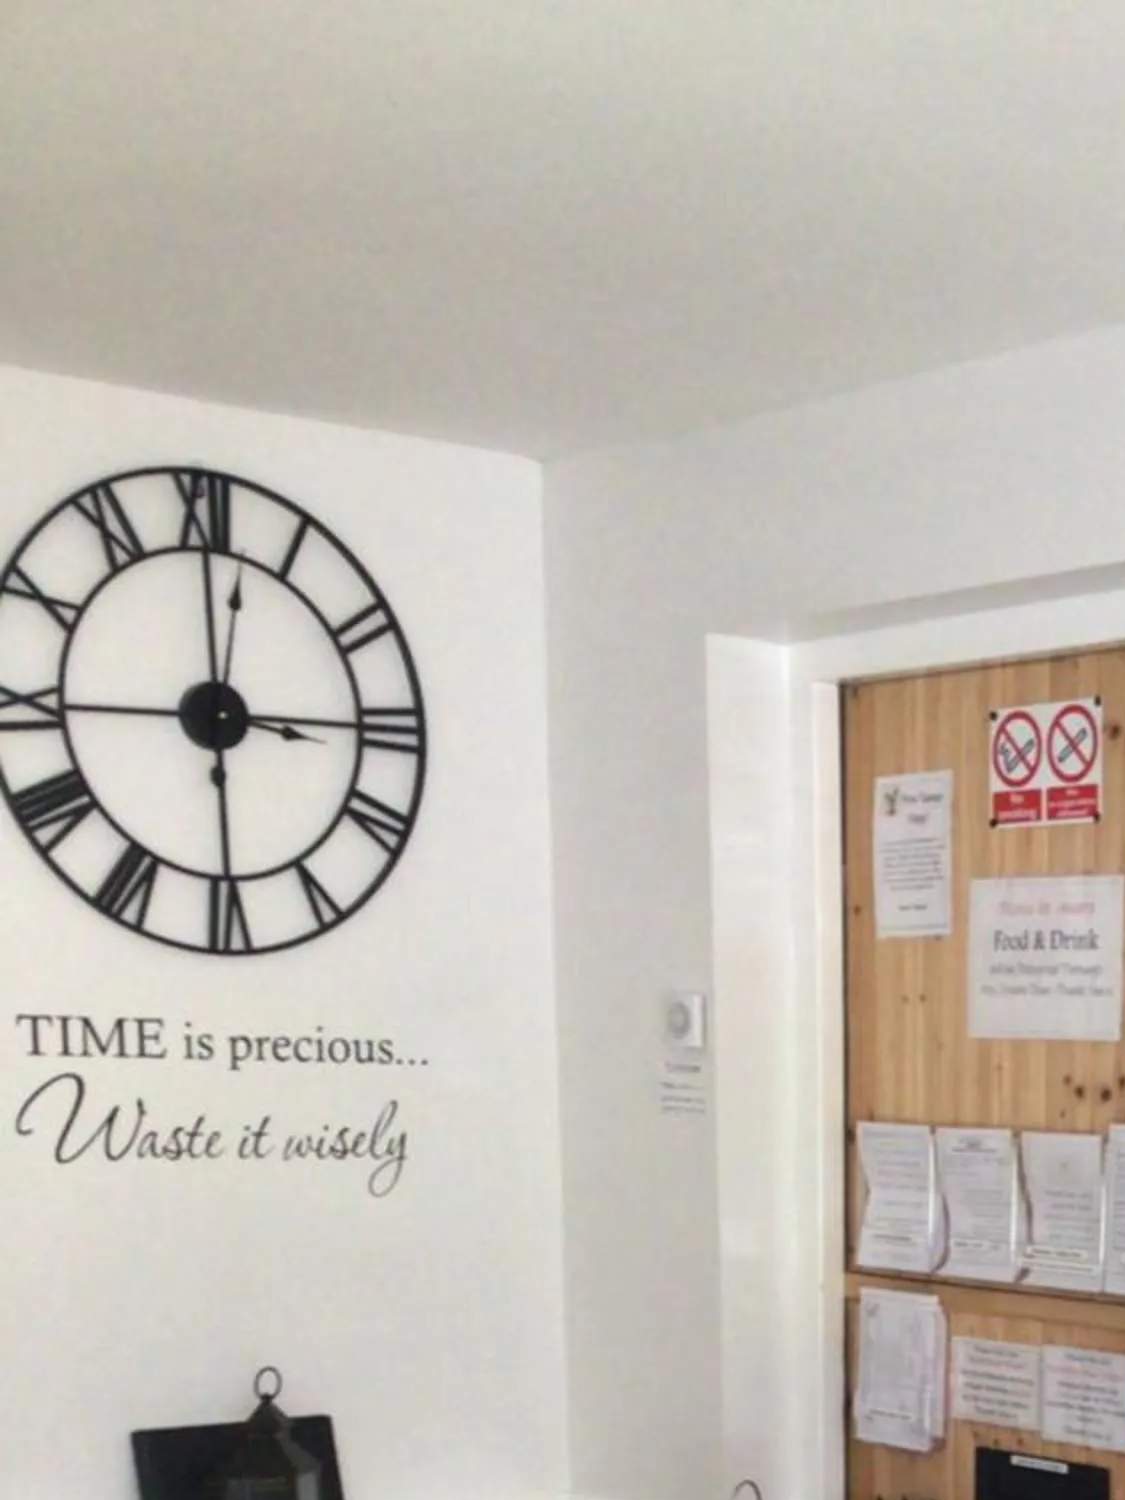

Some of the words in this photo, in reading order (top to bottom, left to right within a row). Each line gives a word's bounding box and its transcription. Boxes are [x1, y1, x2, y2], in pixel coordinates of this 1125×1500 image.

[993, 928, 1030, 953] Food
[1050, 927, 1101, 951] Drink
[15, 1014, 168, 1060] TIME
[183, 1021, 215, 1061] is
[228, 1025, 429, 1072] precious...
[15, 1072, 225, 1165] Waste
[236, 1115, 276, 1161] it
[282, 1099, 409, 1199] wisely
